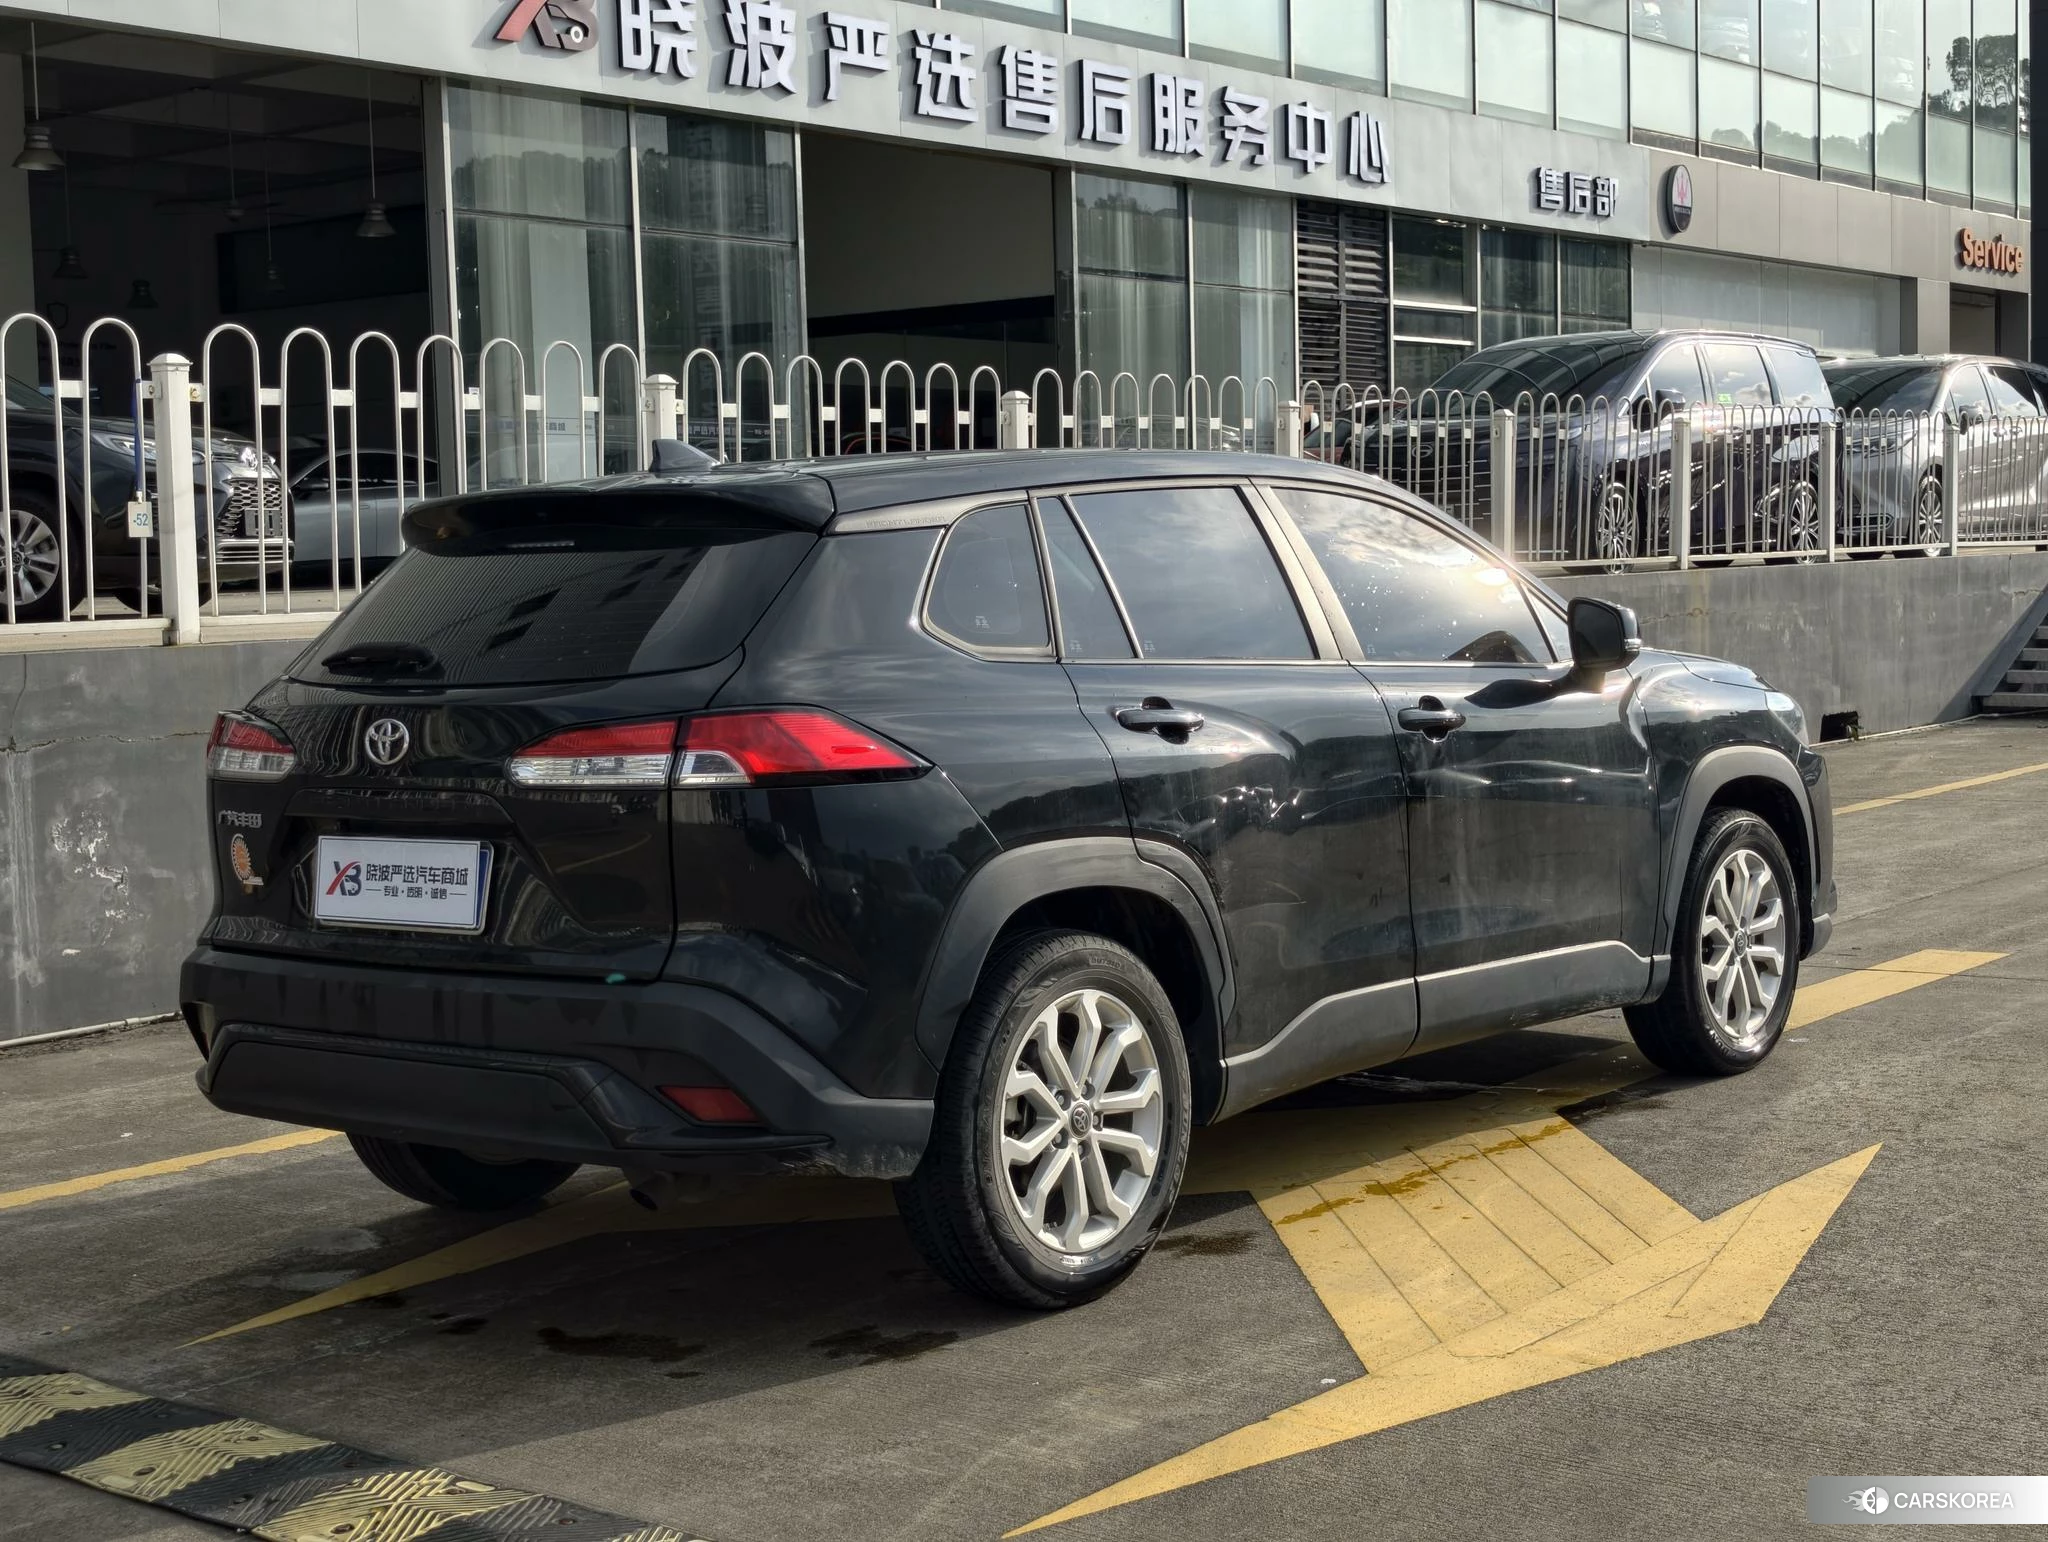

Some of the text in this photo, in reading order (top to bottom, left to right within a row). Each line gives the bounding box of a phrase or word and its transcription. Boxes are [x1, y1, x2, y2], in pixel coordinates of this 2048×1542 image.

[617, 0, 1391, 183] 晓波严选售后服务中心
[1538, 165, 1619, 218] 售后部
[1961, 226, 2025, 273] Service
[365, 862, 469, 886] 晓波严选汽车商城
